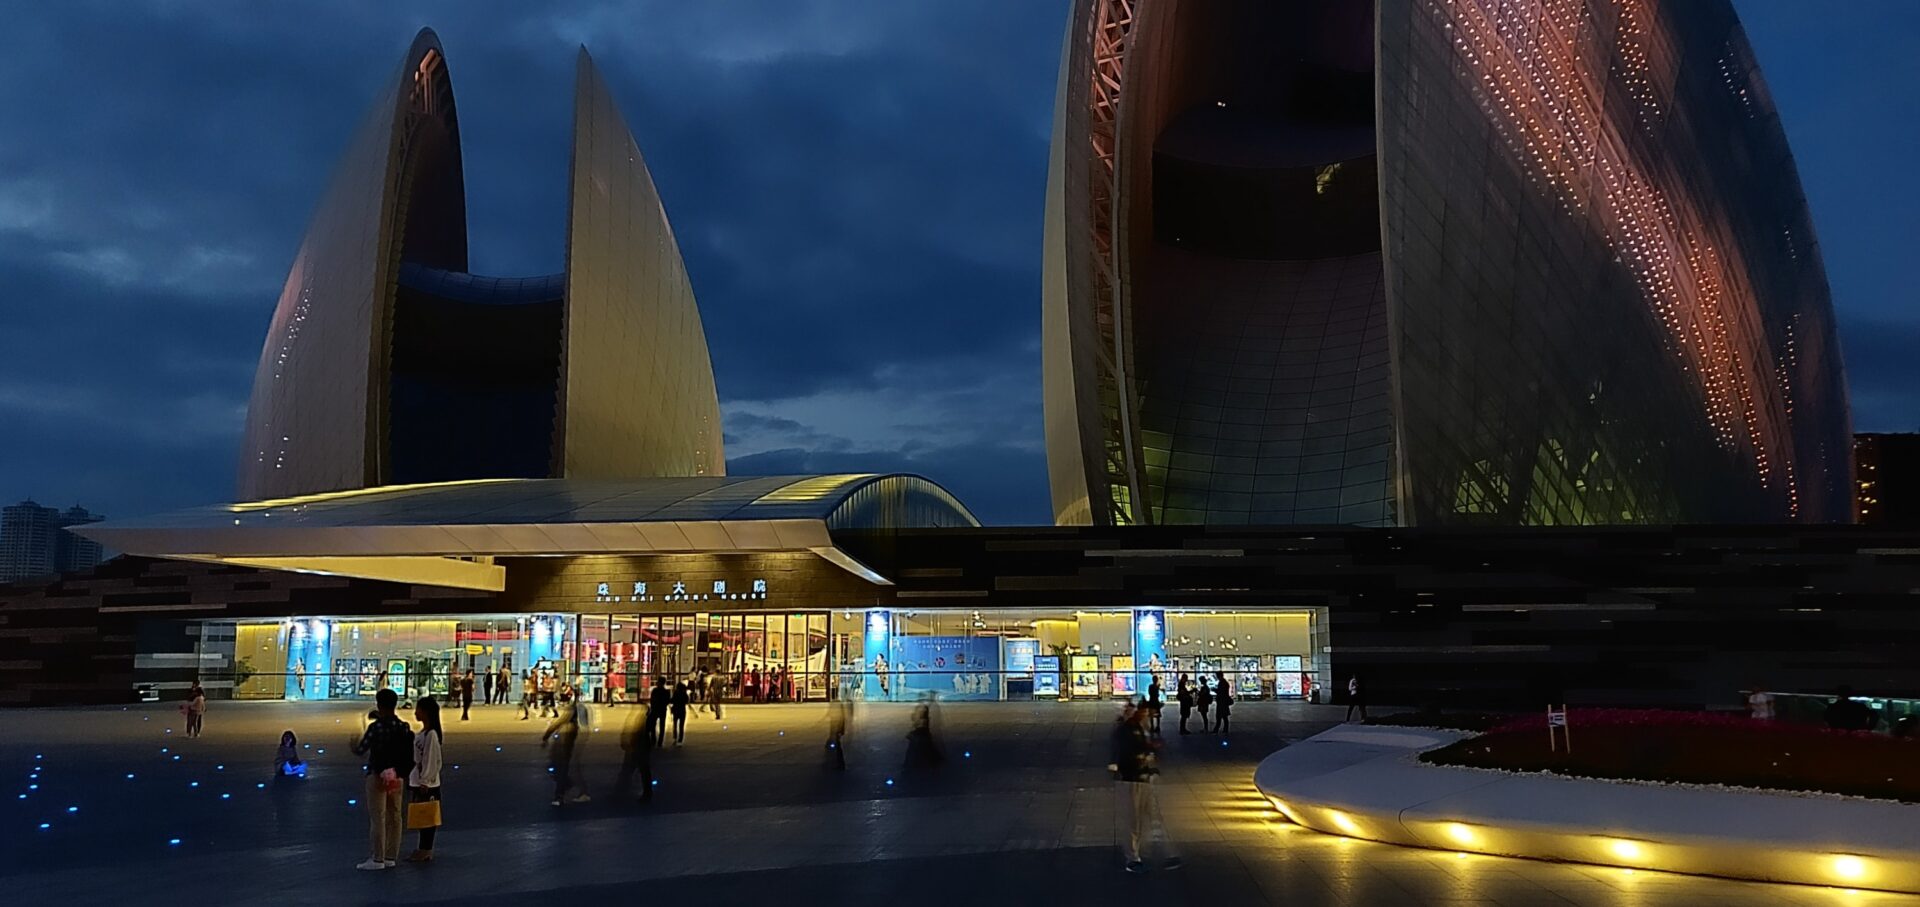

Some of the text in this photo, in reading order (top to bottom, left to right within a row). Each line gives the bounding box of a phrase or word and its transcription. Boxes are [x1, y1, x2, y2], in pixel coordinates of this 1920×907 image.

[597, 580, 767, 595] 珠海大剧院
